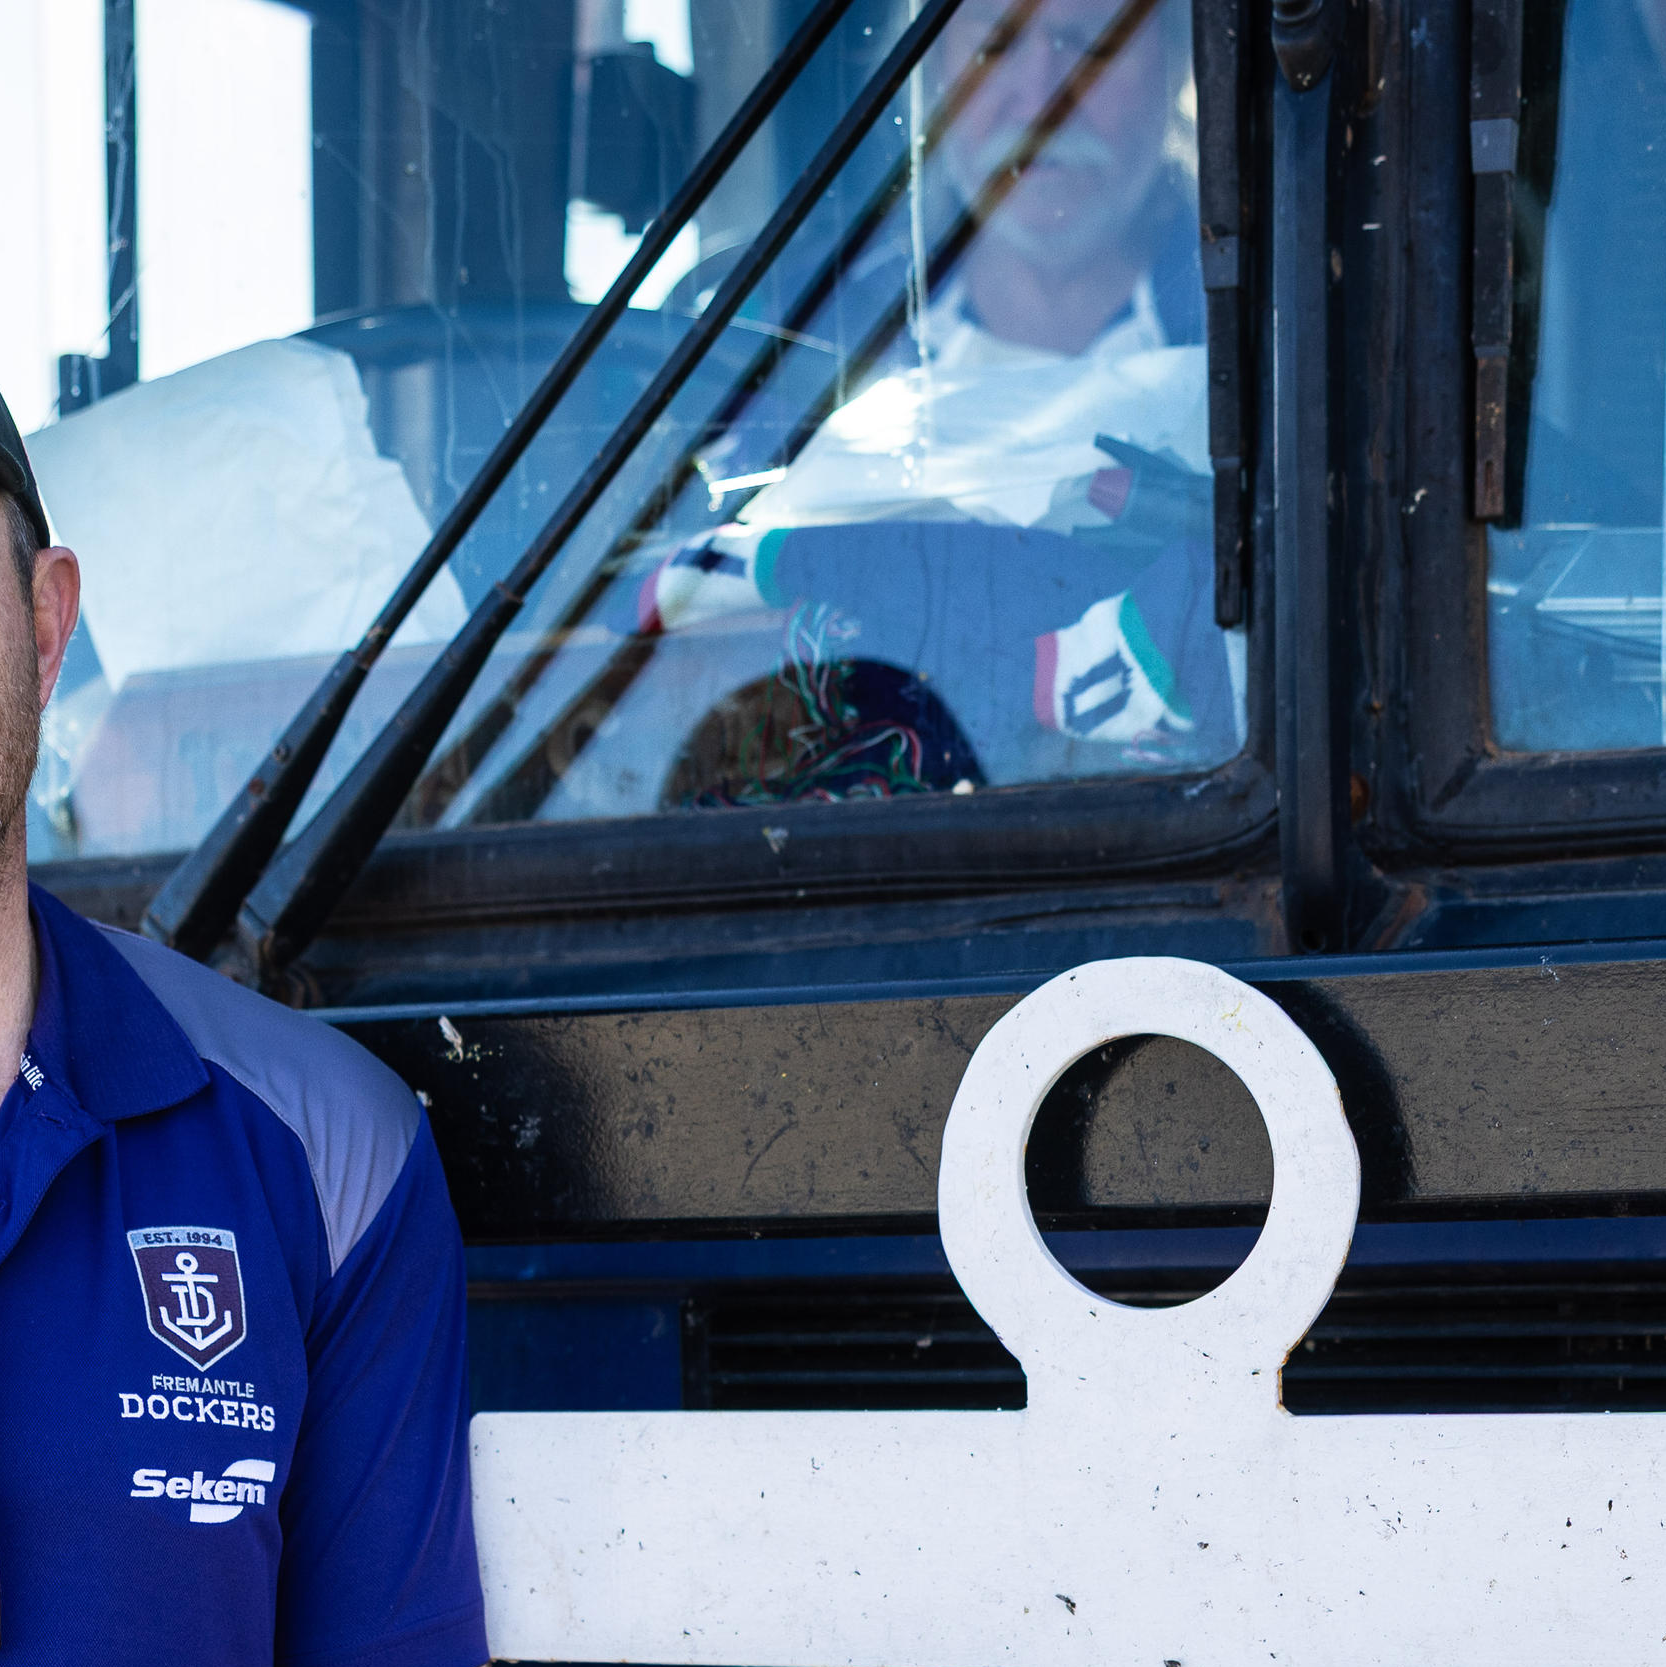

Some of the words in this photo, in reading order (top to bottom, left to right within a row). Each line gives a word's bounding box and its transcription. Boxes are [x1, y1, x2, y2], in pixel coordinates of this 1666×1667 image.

[23, 1065, 45, 1091] life
[143, 1231, 181, 1245] EST.
[186, 1231, 222, 1246] 1994
[152, 1374, 255, 1399] FREMANTLE
[118, 1392, 276, 1432] DOCKERS
[130, 1468, 266, 1506] Sekem
